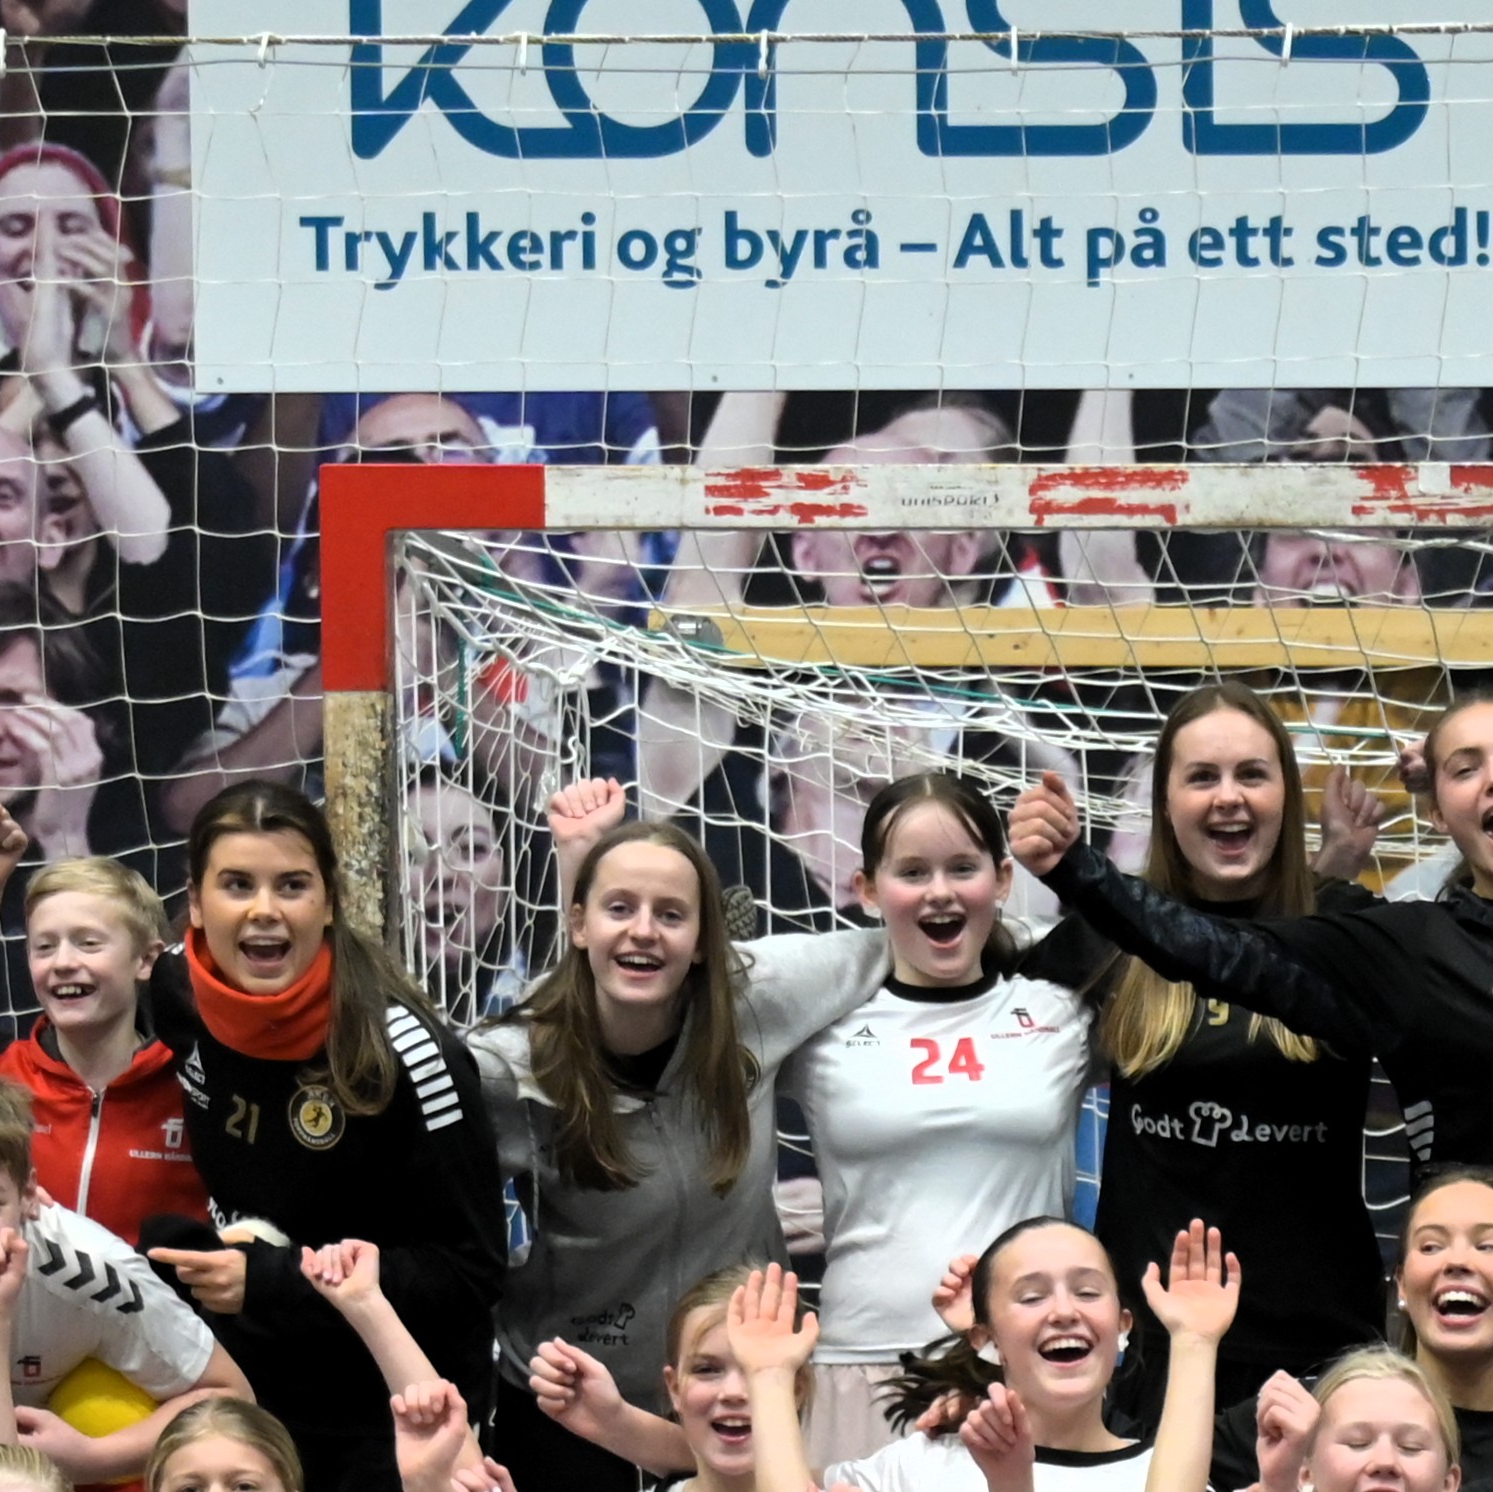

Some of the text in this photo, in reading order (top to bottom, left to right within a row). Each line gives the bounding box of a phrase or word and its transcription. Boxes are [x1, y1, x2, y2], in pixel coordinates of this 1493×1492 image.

[300, 212, 598, 290] Trykkeri
[617, 232, 703, 287] og
[724, 211, 882, 290] byrå
[953, 208, 1064, 267] Alt
[1087, 208, 1189, 286] på
[1187, 214, 1293, 267] ett
[1315, 206, 1491, 267] sted!
[910, 1037, 985, 1084] 24
[225, 1094, 259, 1145] 21
